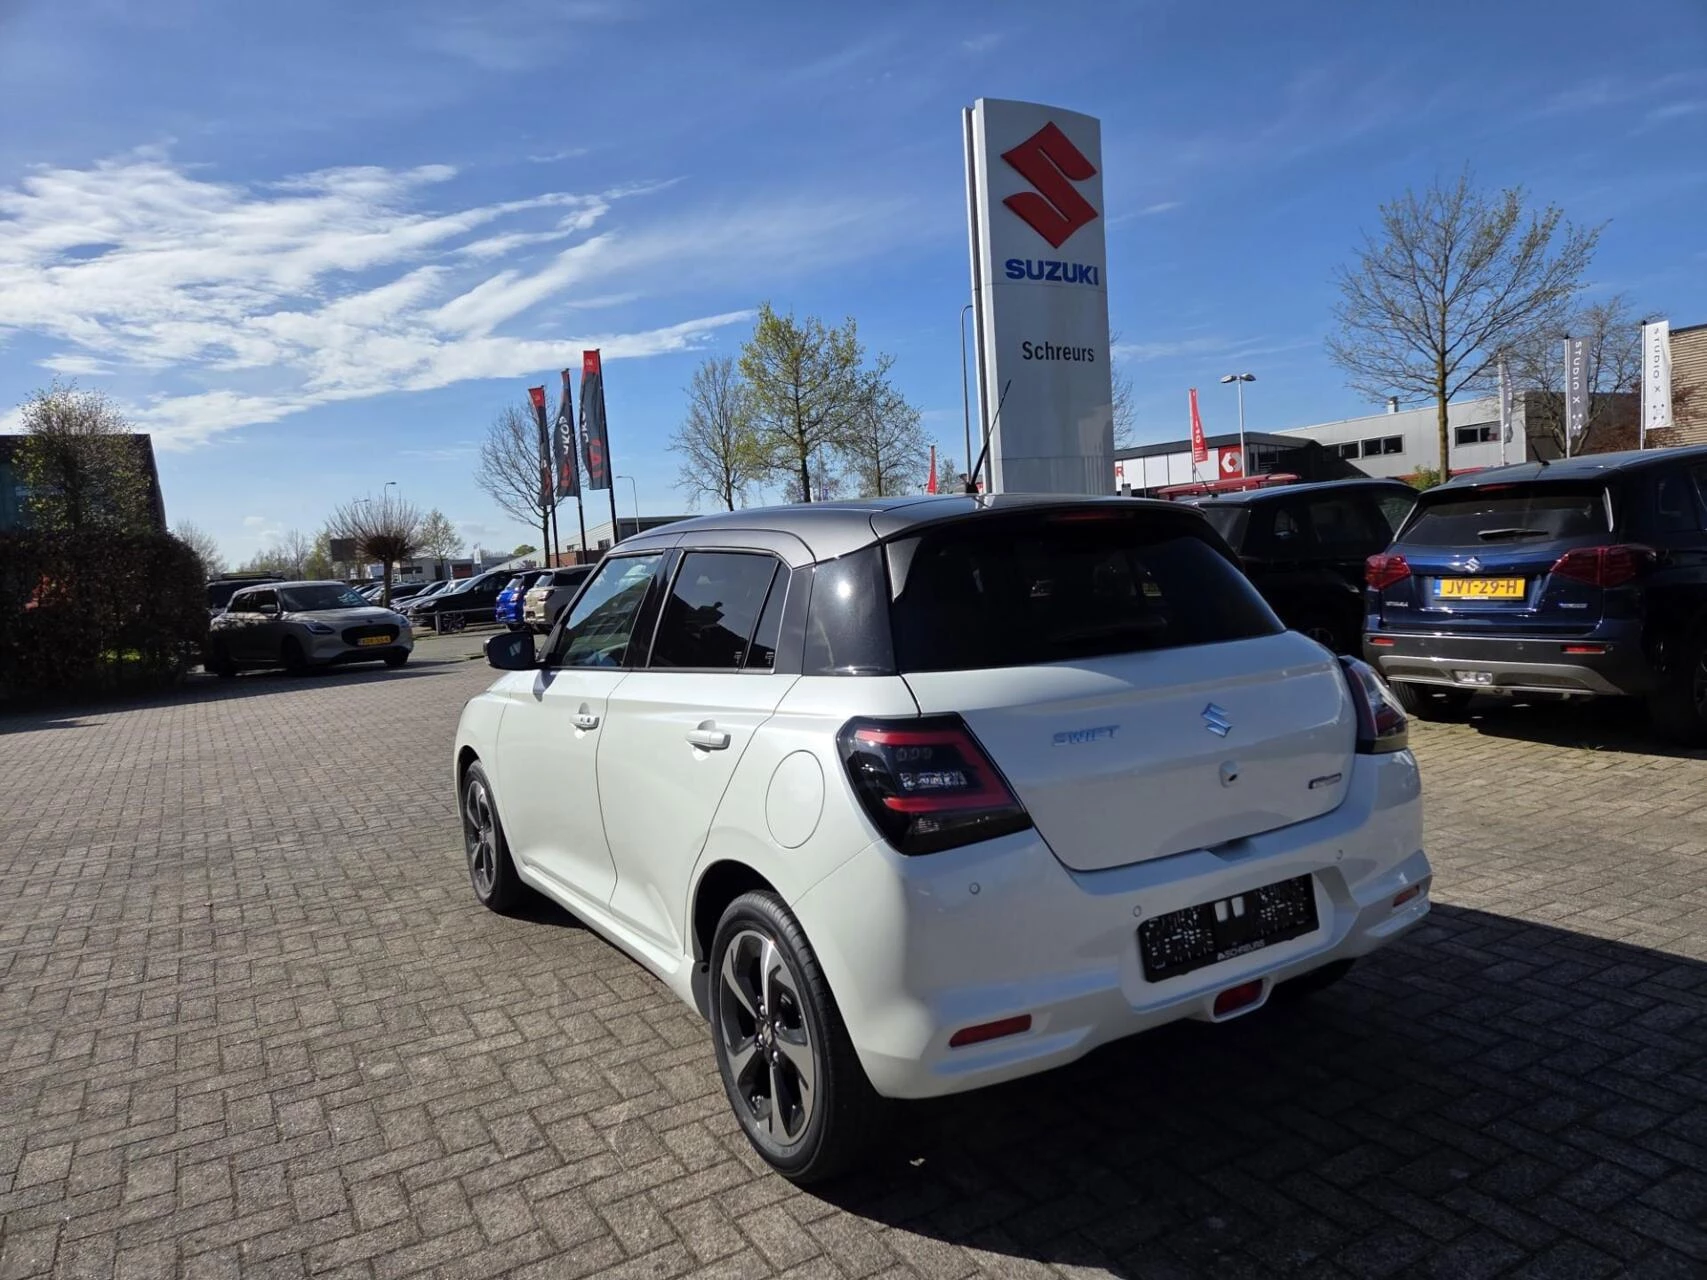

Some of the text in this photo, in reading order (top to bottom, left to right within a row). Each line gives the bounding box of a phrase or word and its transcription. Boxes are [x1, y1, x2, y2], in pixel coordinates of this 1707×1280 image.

[1005, 258, 1100, 286] SUZUKI
[1022, 340, 1095, 363] Schreurs
[1572, 340, 1583, 405] STUDIO X
[1446, 578, 1518, 595] JVT-29-H
[1052, 724, 1121, 746] SWIFT
